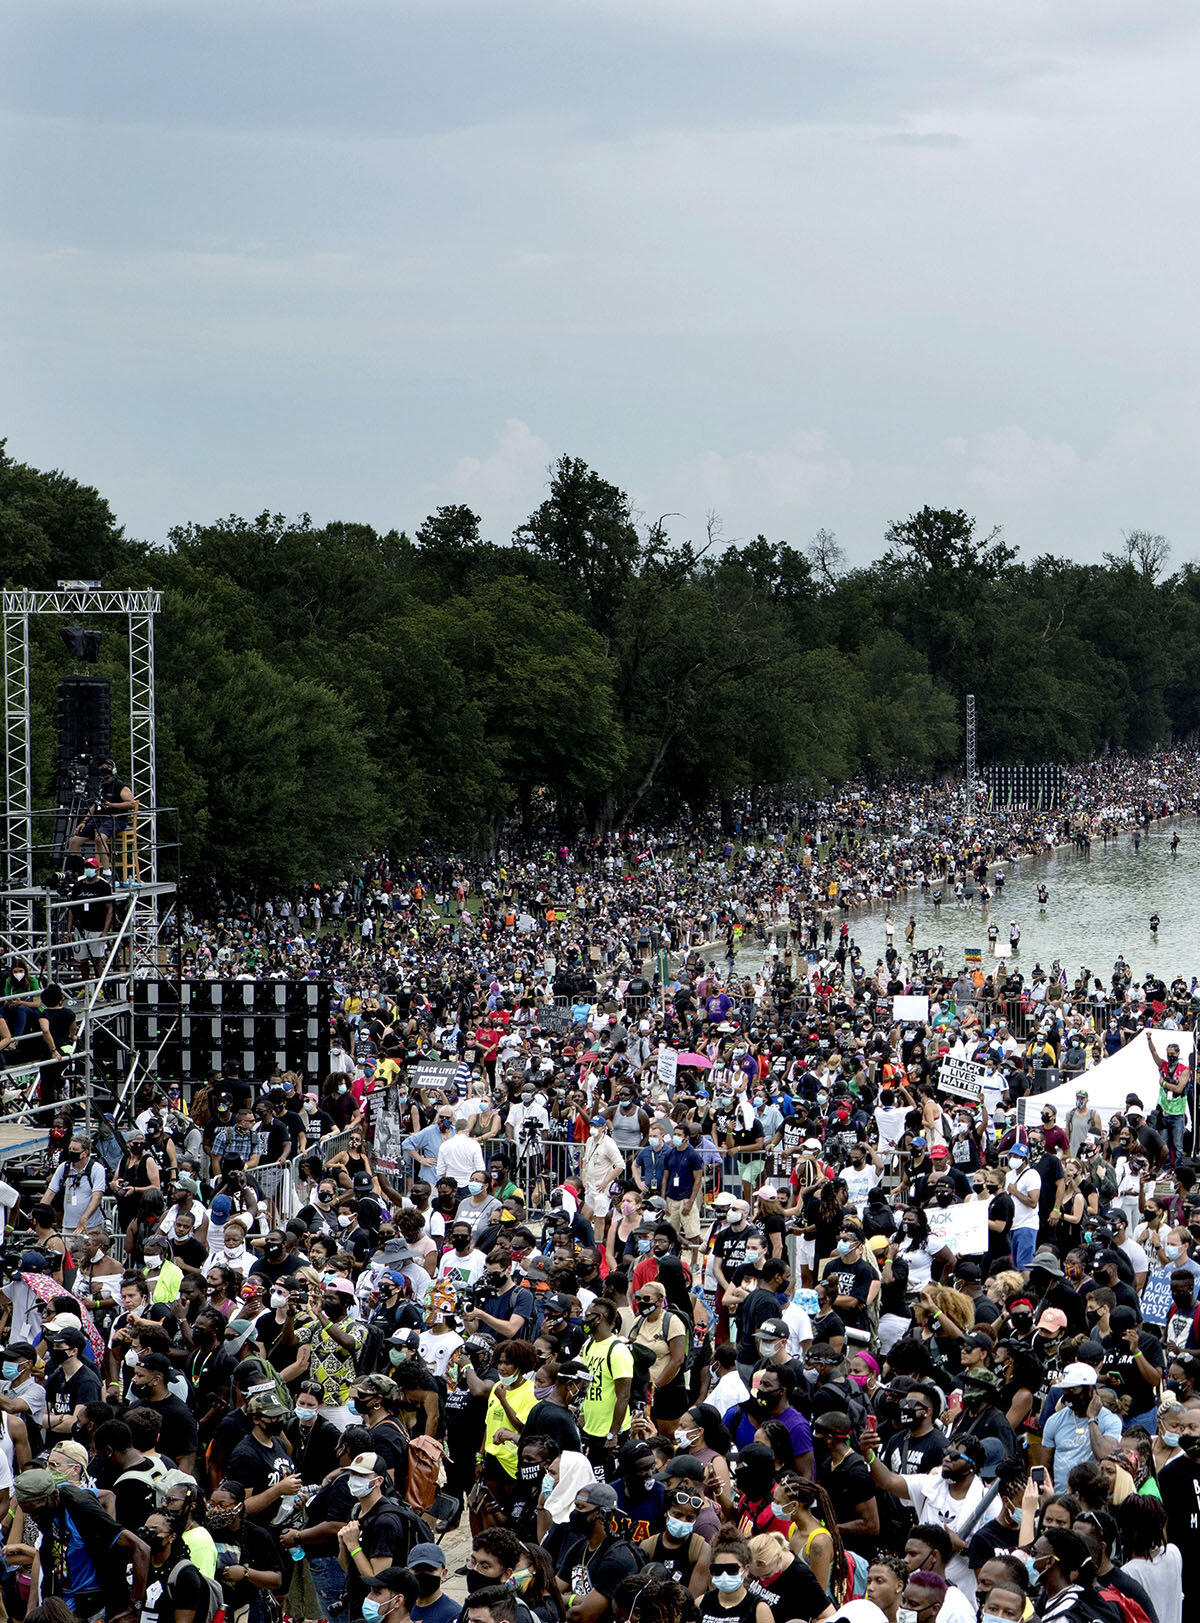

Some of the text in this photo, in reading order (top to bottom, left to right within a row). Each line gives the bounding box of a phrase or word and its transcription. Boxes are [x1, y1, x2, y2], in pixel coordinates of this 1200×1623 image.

[439, 1067, 457, 1075] LIVES
[949, 1055, 981, 1074] BLACK
[950, 1068, 977, 1082] LIVES
[942, 1074, 981, 1093] MATTER
[784, 1123, 807, 1136] BLACK
[929, 1213, 951, 1225] ACK
[1151, 1267, 1165, 1279] WE
[1146, 1281, 1153, 1291] A
[1143, 1291, 1172, 1306] POCKE
